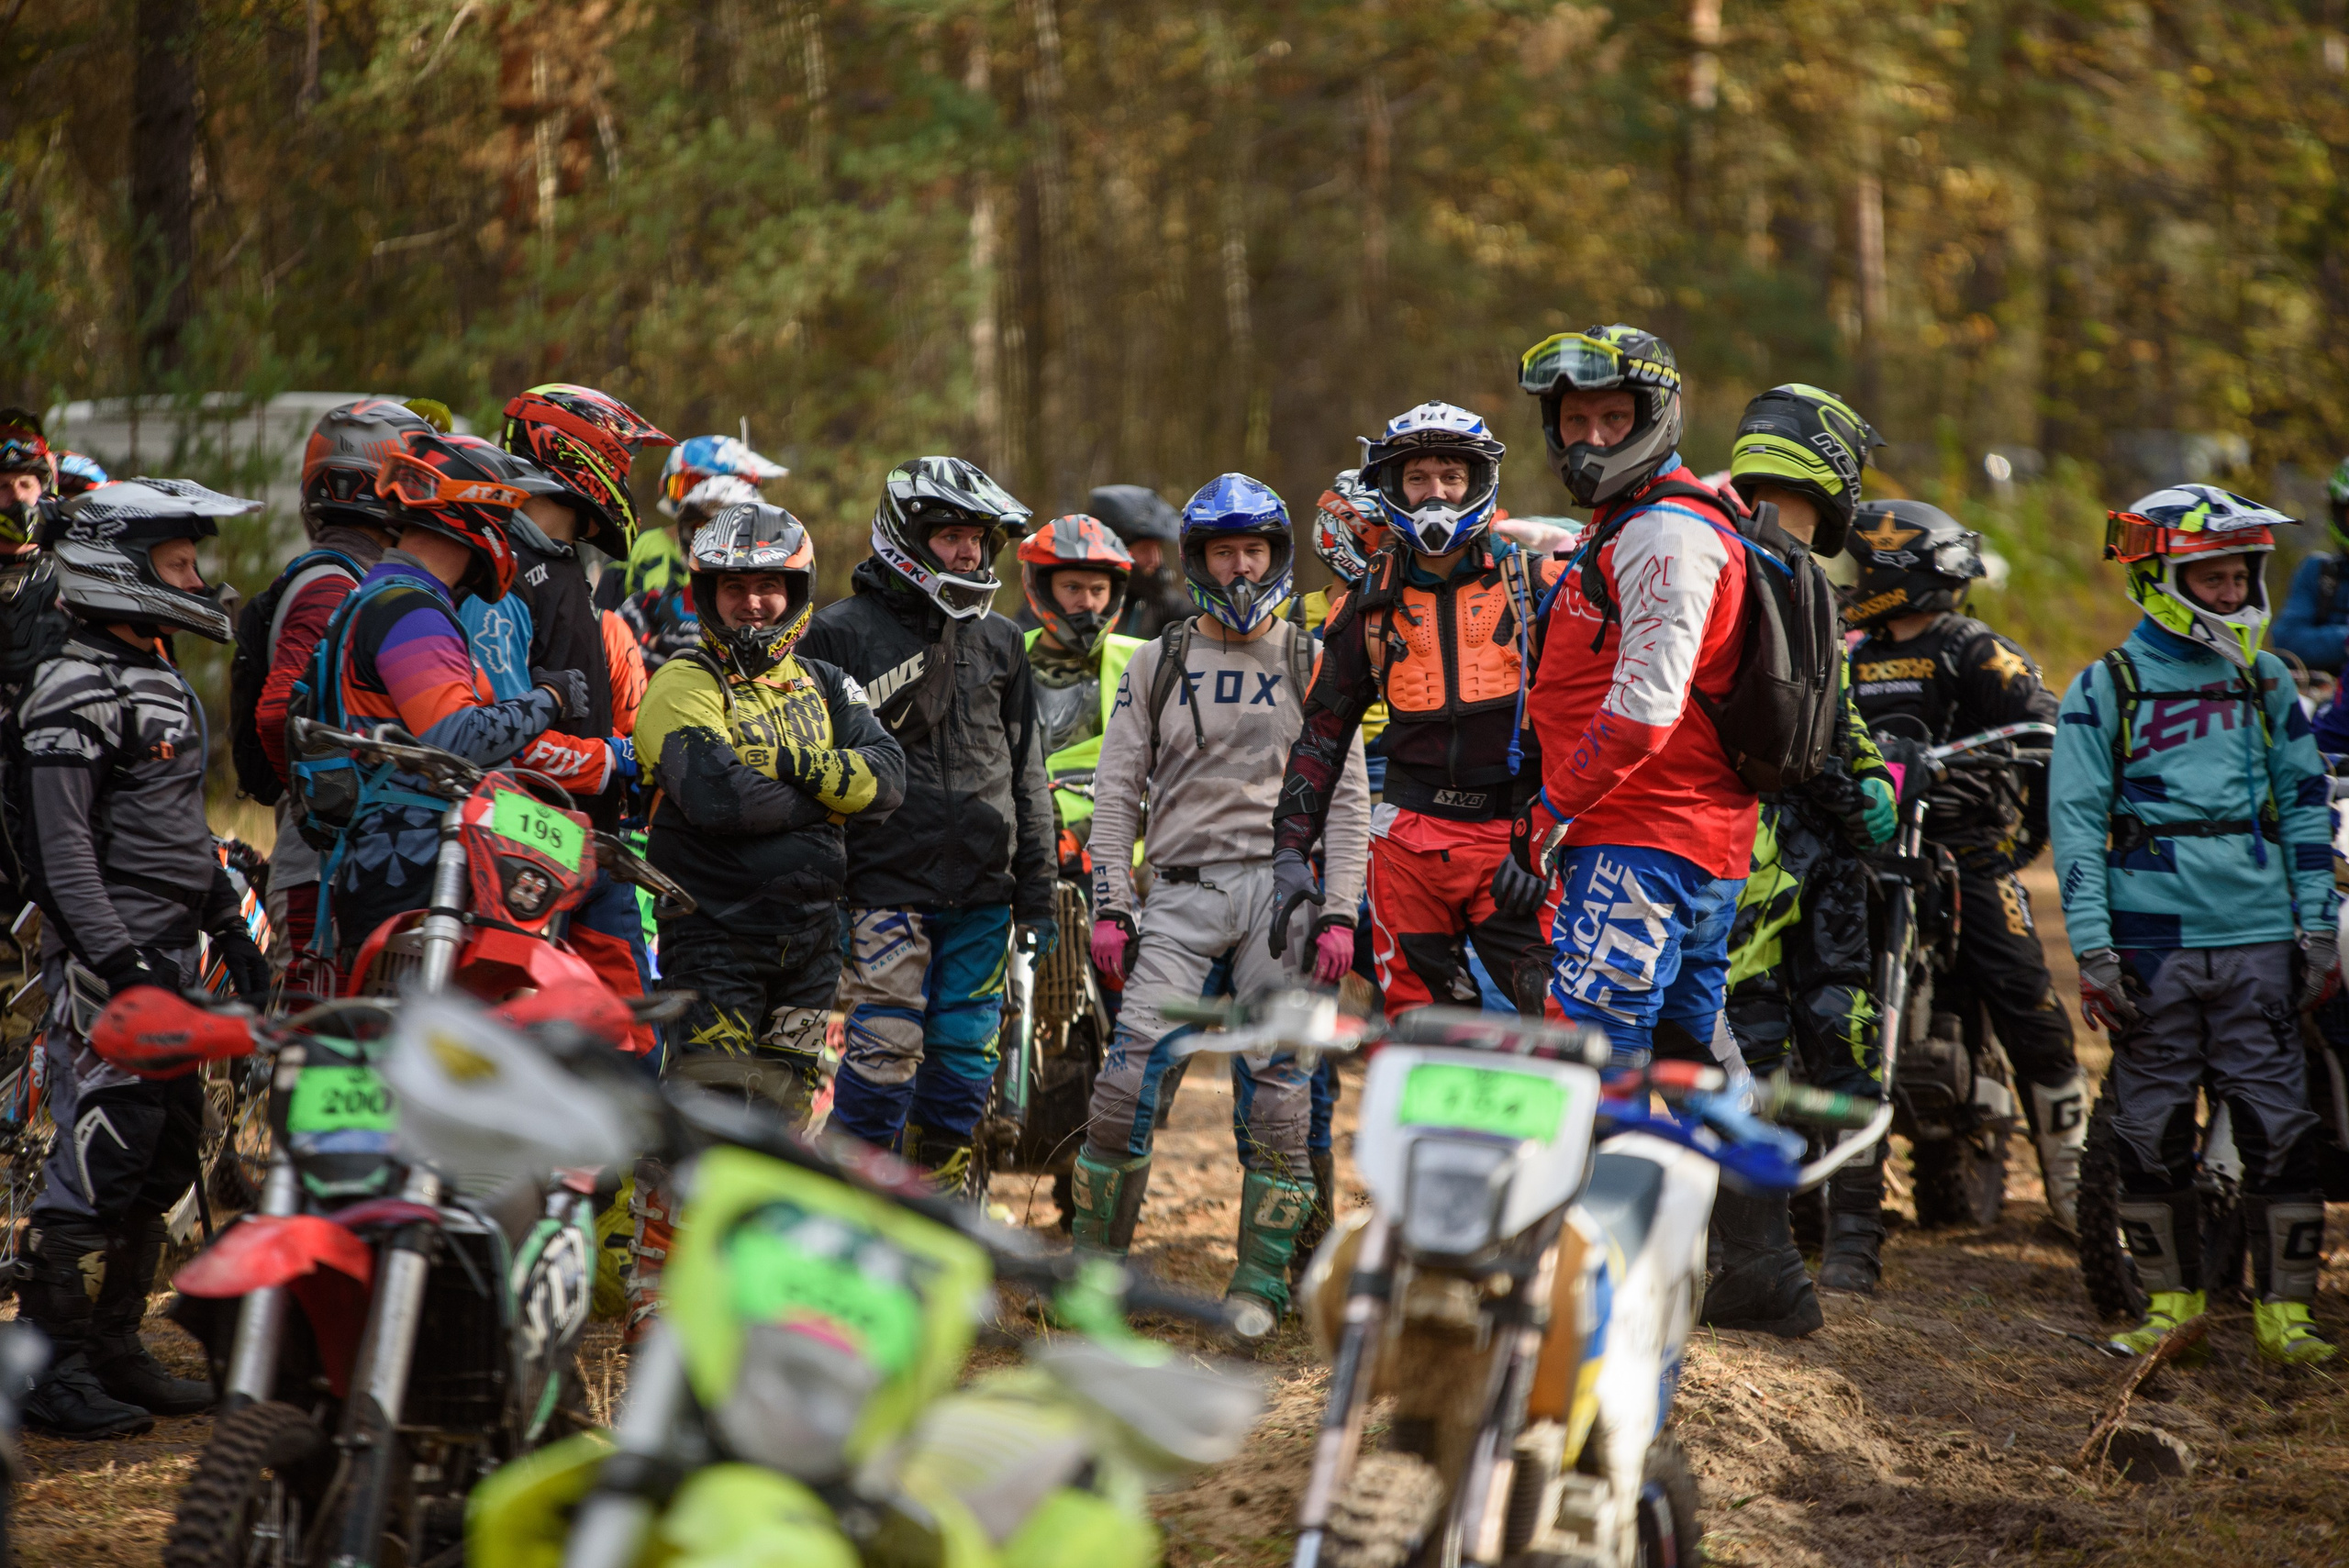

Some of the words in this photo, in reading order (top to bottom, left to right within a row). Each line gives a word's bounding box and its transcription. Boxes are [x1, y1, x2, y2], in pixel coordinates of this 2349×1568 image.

[1326, 498, 1370, 536] ATAKI
[753, 550, 787, 565] Airoh
[881, 548, 929, 584] ATAKI
[1179, 670, 1283, 706] FOX
[523, 740, 593, 776] FOX
[519, 814, 562, 849] 198
[1094, 865, 1110, 907] FOX
[870, 940, 913, 972] RACING
